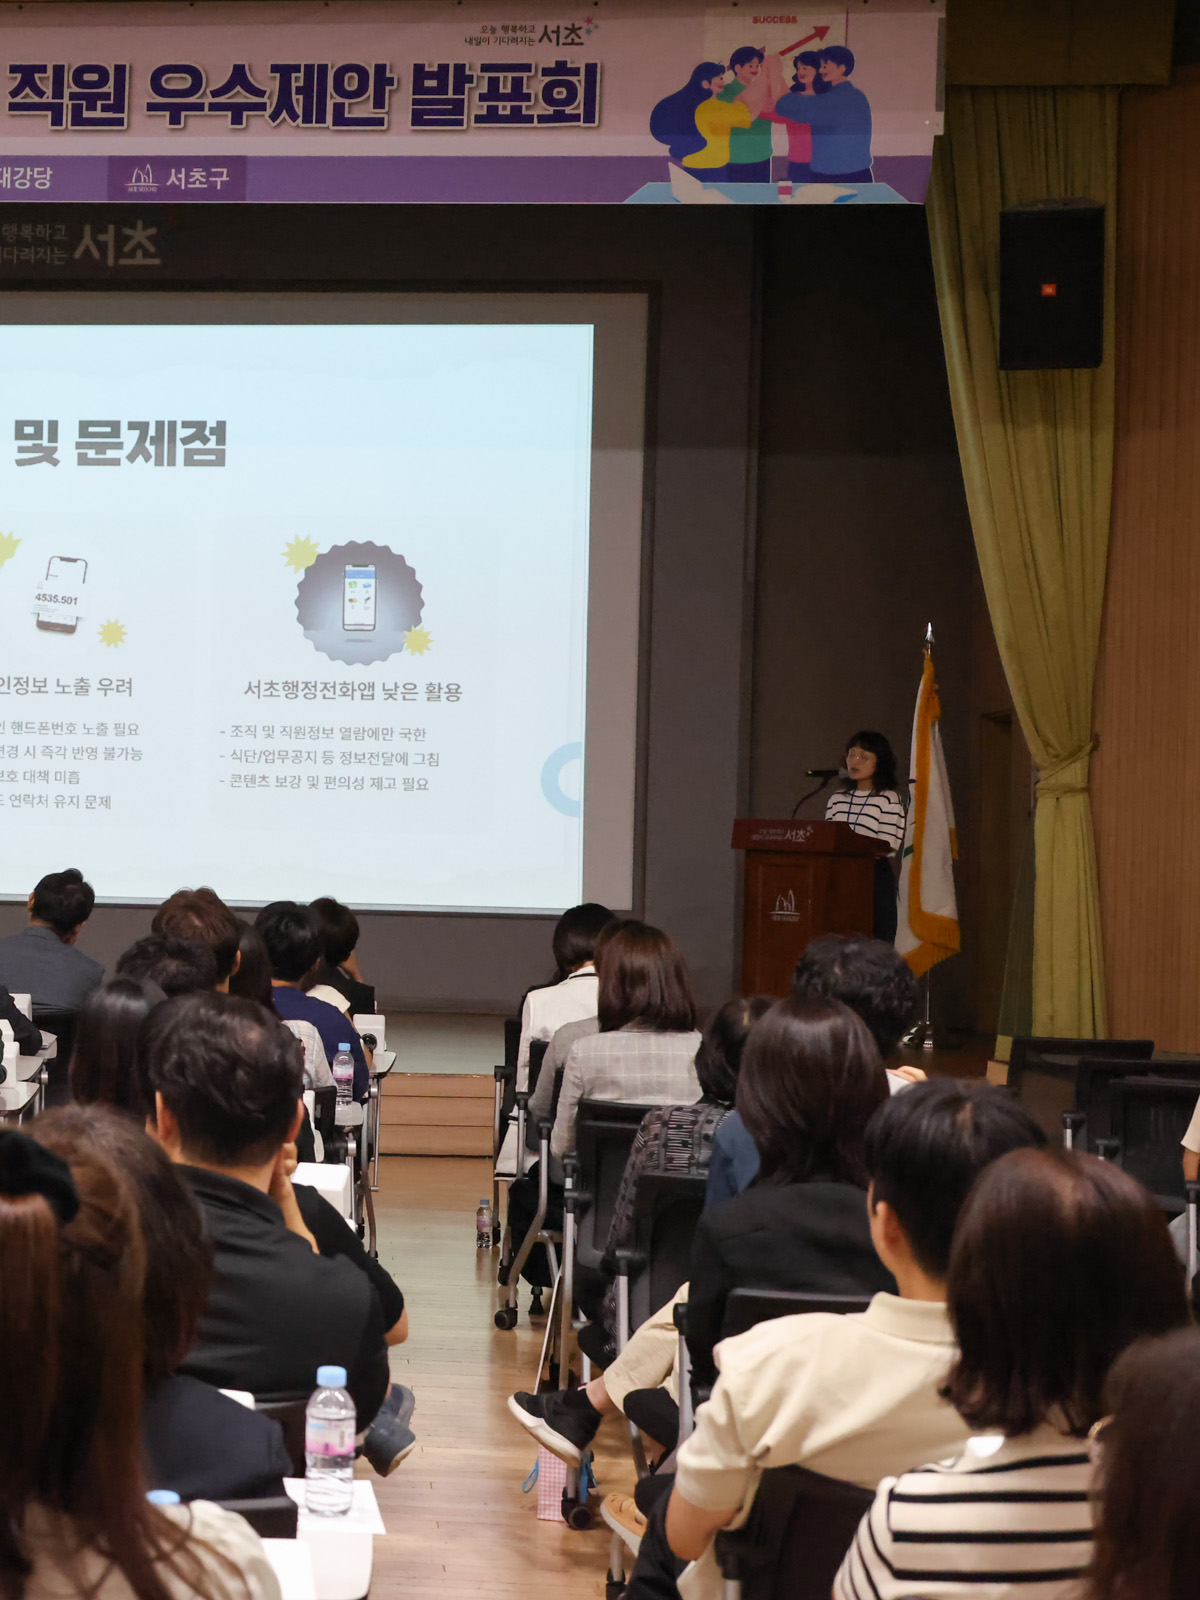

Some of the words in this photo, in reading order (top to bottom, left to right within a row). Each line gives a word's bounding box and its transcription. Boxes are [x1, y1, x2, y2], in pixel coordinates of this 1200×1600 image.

[480, 24, 497, 34] 오늘
[500, 24, 536, 34] 행복하고
[752, 16, 798, 24] SUCCESS
[464, 36, 490, 46] 내일이
[493, 36, 536, 46] 기다려지는
[538, 22, 584, 47] 서초
[6, 62, 129, 129] 직원
[145, 62, 397, 129] 우수제안
[409, 59, 598, 128] 발표회
[166, 167, 230, 190] 서초구
[1, 223, 68, 242] 행복하고
[72, 219, 161, 268] 서초
[14, 419, 60, 467] 및
[75, 419, 227, 467] 문제점
[35, 592, 78, 606] 4535.501
[54, 676, 92, 697] 노출
[96, 677, 133, 698] 우려
[243, 679, 376, 702] 서초행정전화앱
[381, 681, 420, 702] 낮은
[424, 681, 463, 703] 활용
[10, 720, 78, 737] 핸드폰번호
[81, 721, 109, 737] 노출
[113, 722, 140, 737] 필요
[230, 724, 257, 740] 조직
[261, 724, 275, 740] 및
[279, 725, 335, 741] 직원정보
[338, 726, 395, 742] 열람에만
[398, 727, 427, 743] 국한
[23, 744, 36, 760] 시
[40, 745, 68, 761] 즉각
[71, 745, 99, 761] 반영
[102, 746, 144, 762] 불가능
[229, 748, 317, 765] 식단/업무공지
[321, 750, 336, 765] 등
[339, 750, 409, 767] 정보전달에
[412, 752, 440, 768] 그침
[22, 769, 50, 785] 대책
[54, 770, 81, 785] 미흡
[229, 773, 271, 789] 콘텐츠
[274, 774, 303, 790] 보강
[306, 775, 320, 790] 및
[323, 775, 365, 791] 편의성
[369, 776, 397, 791] 제고
[401, 776, 430, 792] 필요
[8, 793, 49, 809] 연락처
[52, 794, 80, 810] 유지
[84, 794, 112, 810] 문제
[784, 828, 806, 842] 서초
